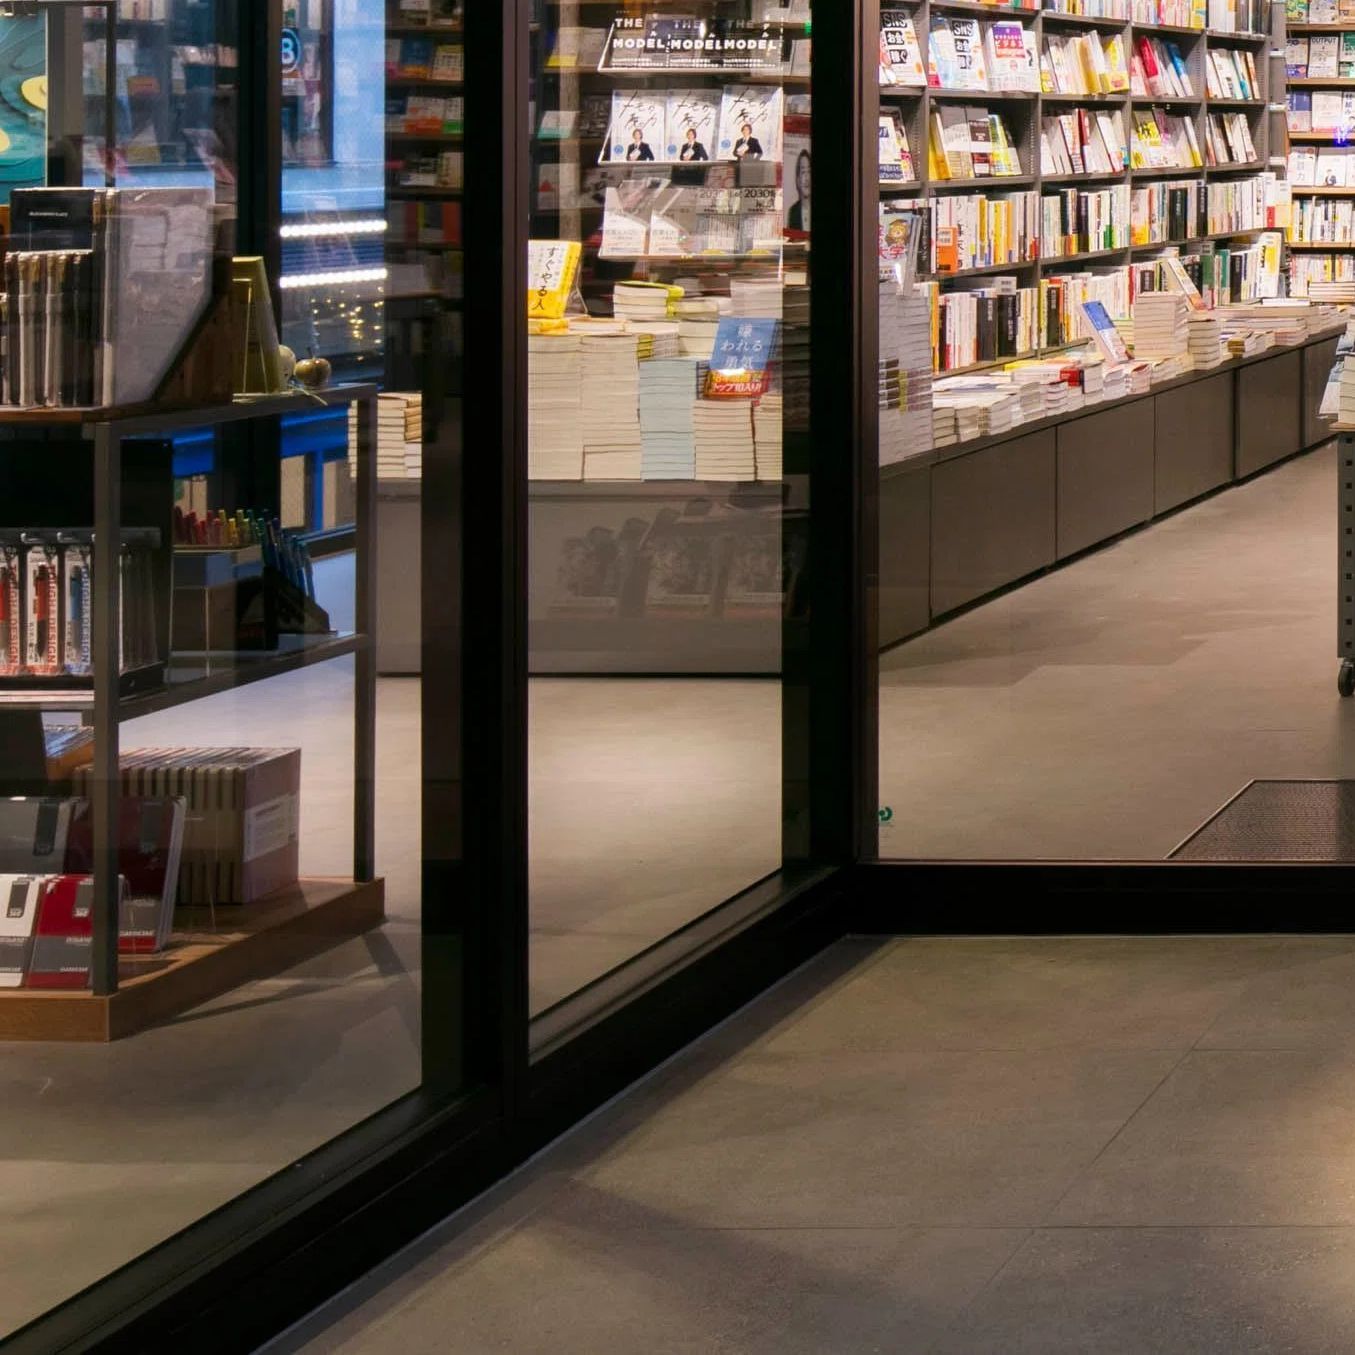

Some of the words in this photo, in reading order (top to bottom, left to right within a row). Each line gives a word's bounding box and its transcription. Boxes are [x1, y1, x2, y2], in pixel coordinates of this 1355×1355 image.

[615, 18, 643, 28] THE
[613, 38, 665, 48] MODEL
[670, 39, 724, 50] MODEL
[724, 39, 777, 50] MODEL
[531, 246, 558, 311] すぐやる人
[719, 340, 762, 352] われる
